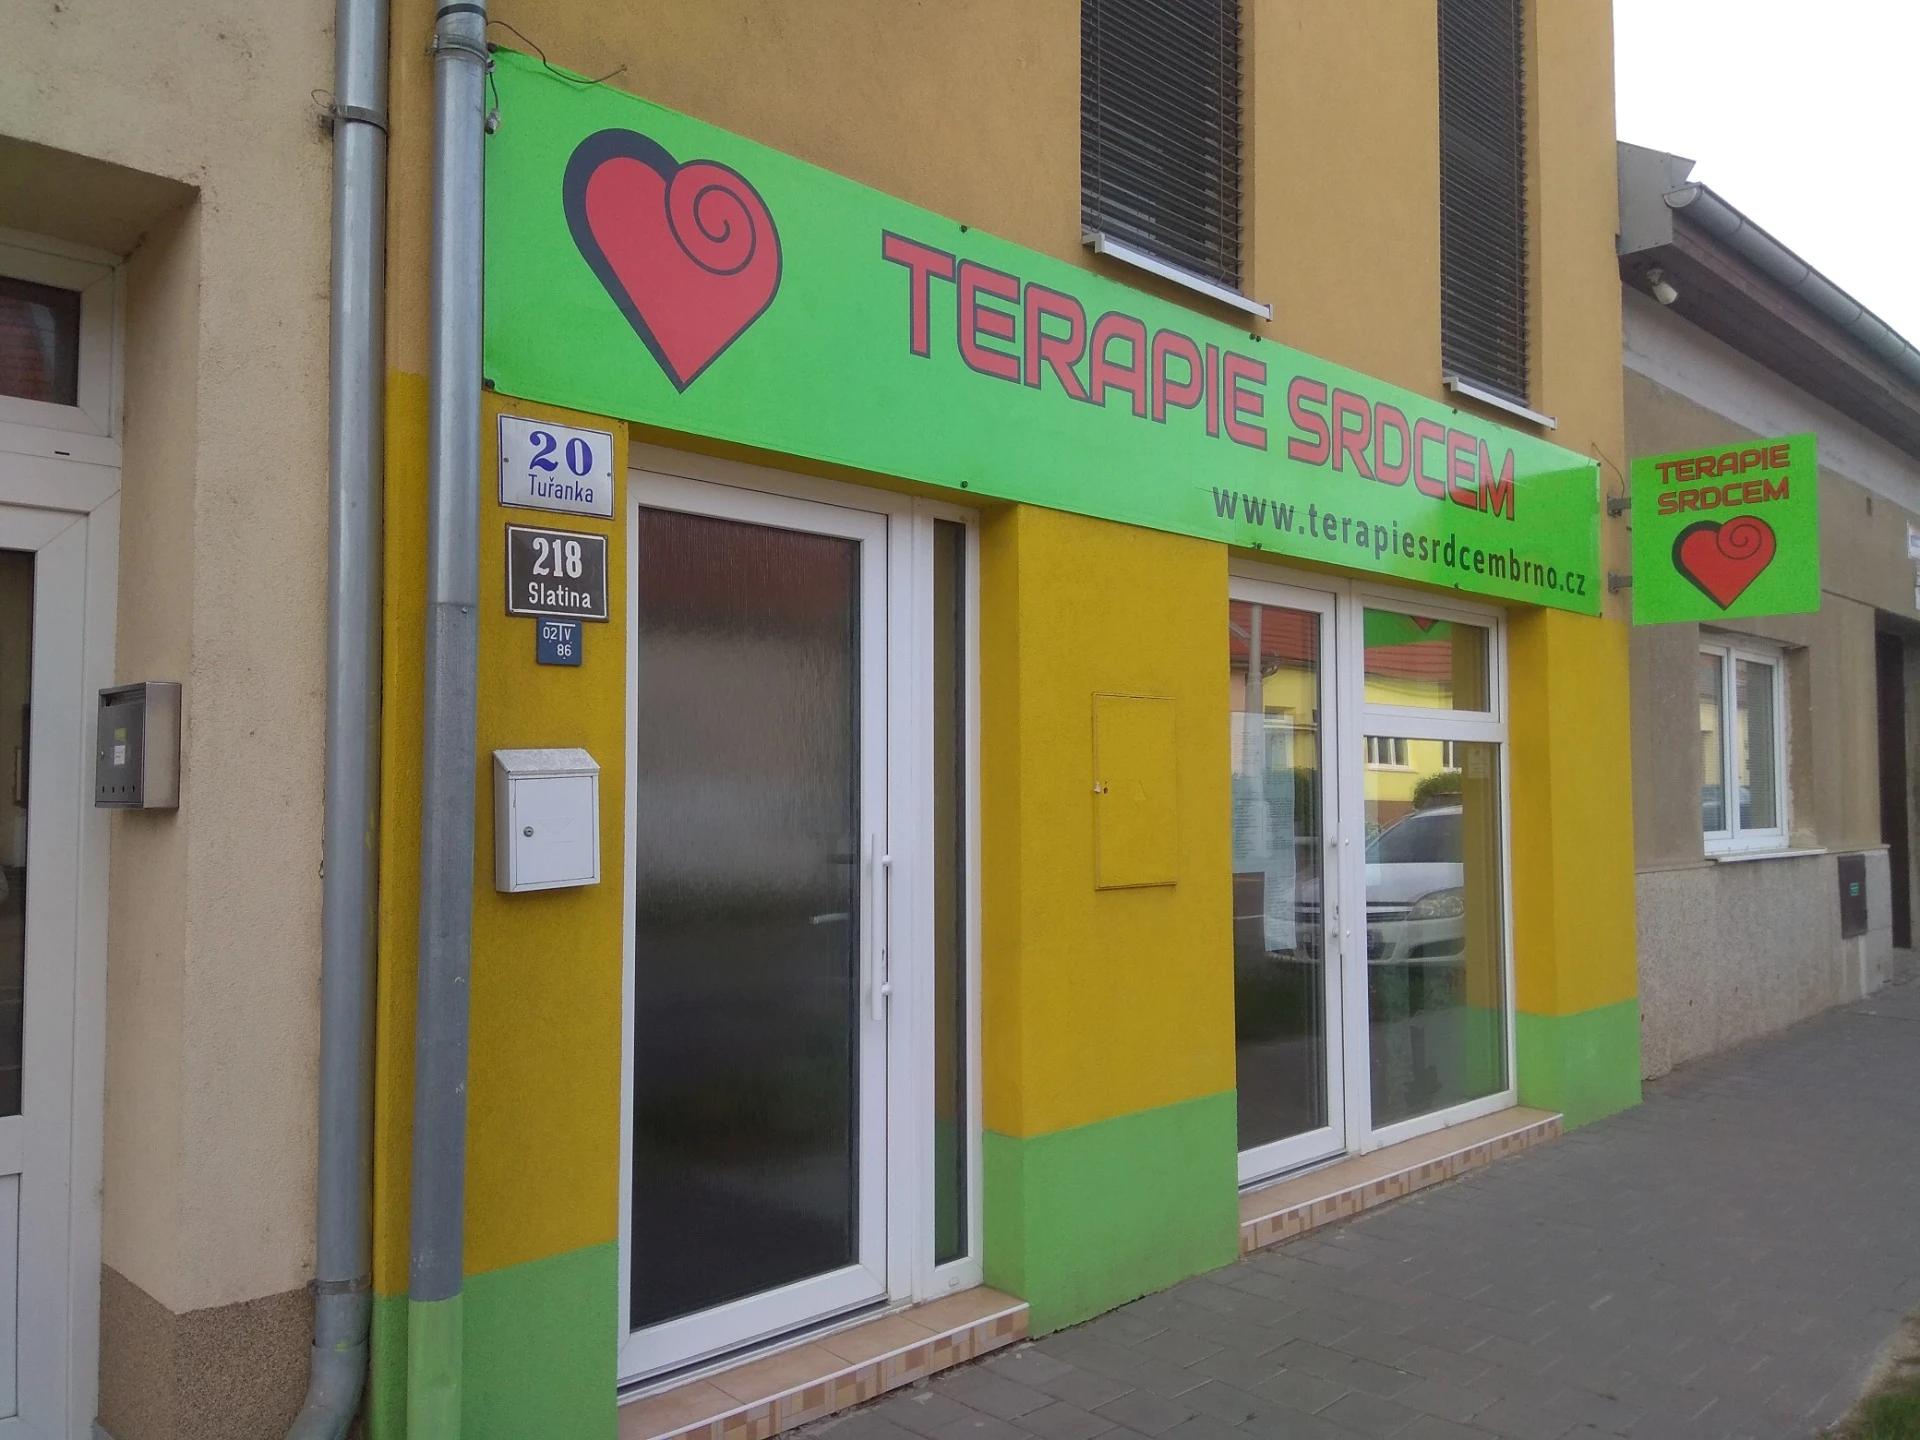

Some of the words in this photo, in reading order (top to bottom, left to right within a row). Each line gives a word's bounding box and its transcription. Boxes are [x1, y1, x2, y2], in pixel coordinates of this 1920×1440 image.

[882, 229, 1268, 451] TERAPIE
[1288, 375, 1515, 521] SRDCEM
[529, 430, 593, 476] 20
[1655, 444, 1791, 485] TERAPIE
[528, 473, 594, 503] Tuřanka
[1657, 476, 1789, 515] SRDCEM
[532, 537, 583, 578] 218
[1212, 486, 1587, 596] www.terapiesrdcembrno.cz
[528, 581, 592, 609] Slatina
[556, 643, 572, 657] 86
